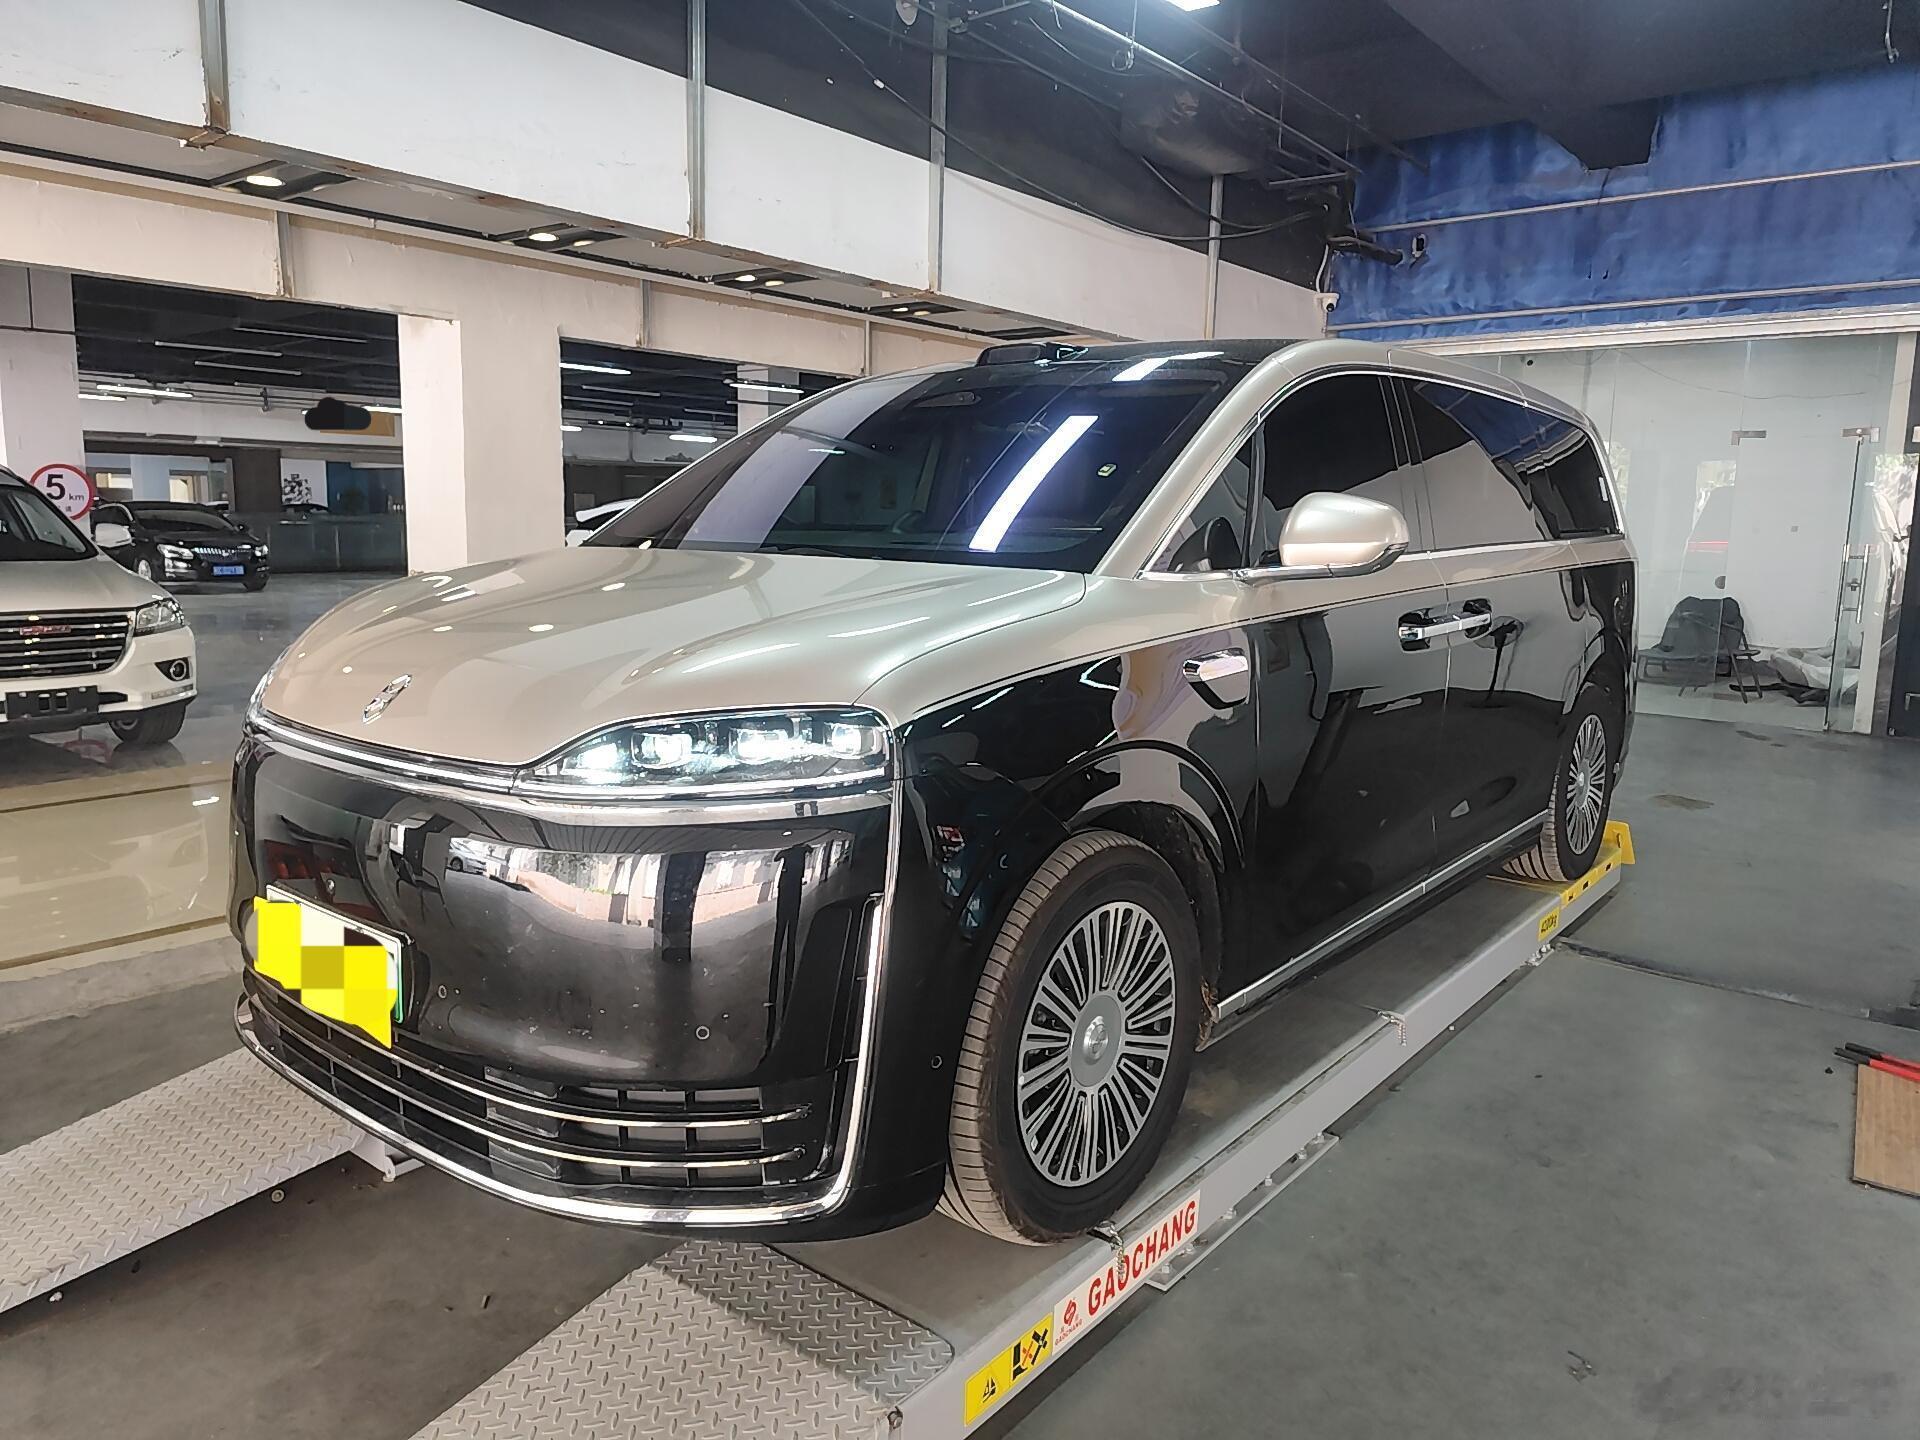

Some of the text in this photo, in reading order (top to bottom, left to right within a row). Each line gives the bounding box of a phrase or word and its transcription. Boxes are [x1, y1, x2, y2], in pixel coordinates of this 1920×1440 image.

[46, 474, 85, 501] 5 km
[1088, 1200, 1196, 1316] GAOCHANG
